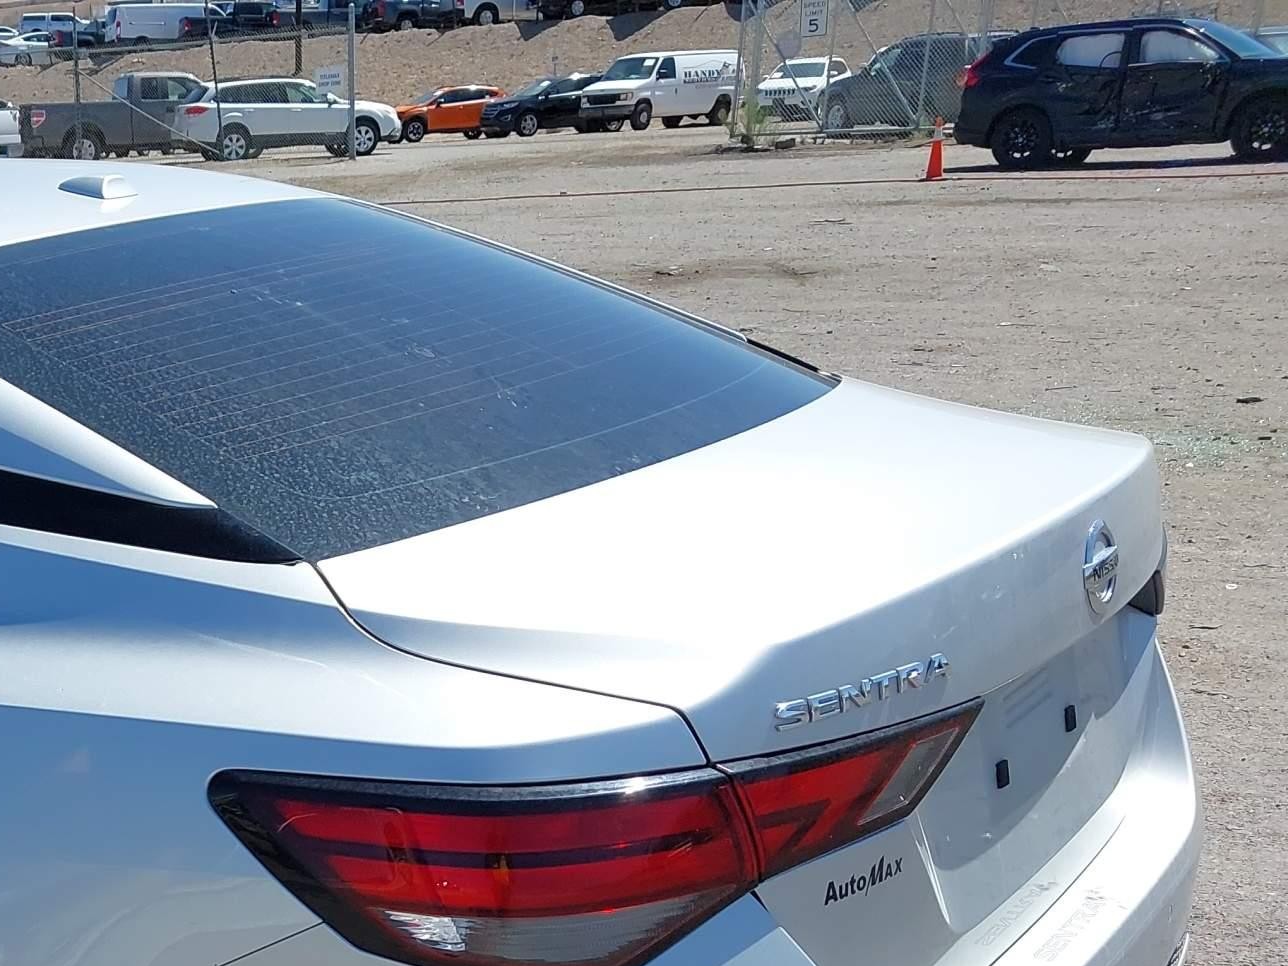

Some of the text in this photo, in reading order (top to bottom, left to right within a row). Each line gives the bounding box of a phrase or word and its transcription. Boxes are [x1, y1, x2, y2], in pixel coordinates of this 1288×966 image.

[804, 1, 825, 9] SPEED
[808, 18, 819, 33] 5
[684, 69, 722, 78] HANDY
[774, 652, 950, 732] SENTRA
